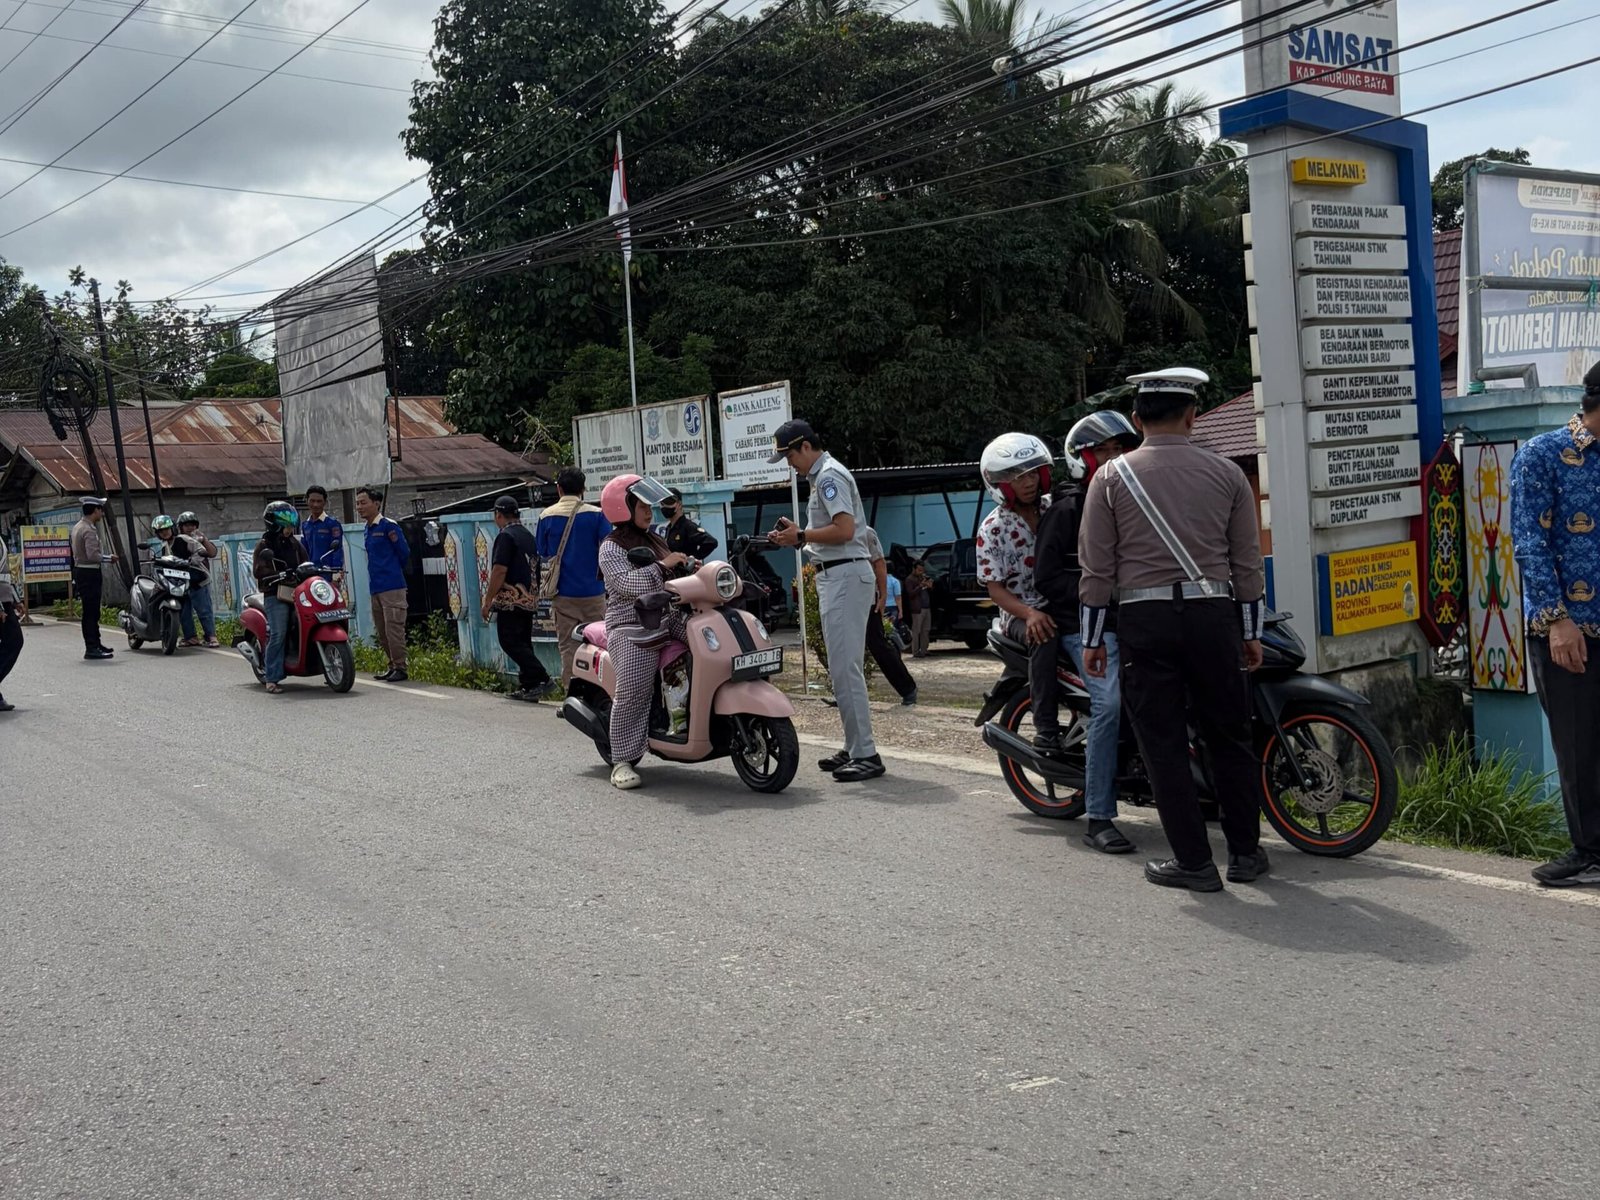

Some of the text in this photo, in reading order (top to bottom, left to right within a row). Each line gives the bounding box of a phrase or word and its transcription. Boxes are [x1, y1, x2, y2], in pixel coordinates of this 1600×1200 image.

[1287, 24, 1393, 72] SAMSAT
[1296, 66, 1320, 82] KAB.
[1364, 76, 1388, 91] RAYA
[1307, 161, 1360, 179] MELAYANI
[1311, 204, 1388, 218] PEMBAYARAN PAJAK
[1312, 217, 1360, 230] KENDARAAN
[1314, 241, 1387, 253] PENGESAHAN STNK
[1315, 254, 1352, 265] TAHUNAN
[1316, 278, 1408, 290] REGISTRASI KENDARAAN
[1316, 290, 1410, 302] DAN PERUBAHAN NOMOR
[1317, 303, 1388, 314] POLISI 5 TAHUNAN
[1320, 327, 1384, 340] BEA BALIK NAMA
[1321, 339, 1410, 353] KENDARAAN BERMOTOR
[1322, 352, 1391, 365] KENDARAAN BARU
[1323, 374, 1399, 389] GANTI KEPEMILIKAN
[1323, 386, 1412, 402] KENDARAAN BERMOTOR
[733, 400, 750, 413] BANK
[750, 395, 781, 410] KALTENG
[1325, 409, 1401, 424] MUTASI KENDARAAN
[746, 424, 767, 435] KANTOR
[1326, 424, 1369, 437] BERMOTOR
[646, 439, 704, 456] KANTOR BERSAMA
[735, 438, 754, 449] CABANG
[661, 453, 687, 467] SAMSAT
[727, 453, 739, 463] UNIT
[739, 450, 757, 461] SAMSAT
[1327, 445, 1400, 462] PENCETAKAN TANDA
[1328, 458, 1394, 474] BUKTI PELUNASAN
[1329, 467, 1418, 487] KEWAJIBAN PEMBAYARAN
[1330, 491, 1402, 511] PENCETAKAN STNK
[1331, 509, 1368, 524] DUPLIKAT
[1333, 547, 1410, 568] PELAYANAN BERKUALITAS
[1334, 561, 1392, 578] SESUAI VISI & MISI
[1335, 569, 1411, 599] BADAN PENDAPATAN
[1374, 581, 1398, 591] DAERAH
[1336, 596, 1371, 612] PROVINSI
[1336, 602, 1402, 622] KALIMANTAN TENGAH
[735, 655, 746, 668] KH
[748, 652, 768, 665] 3403
